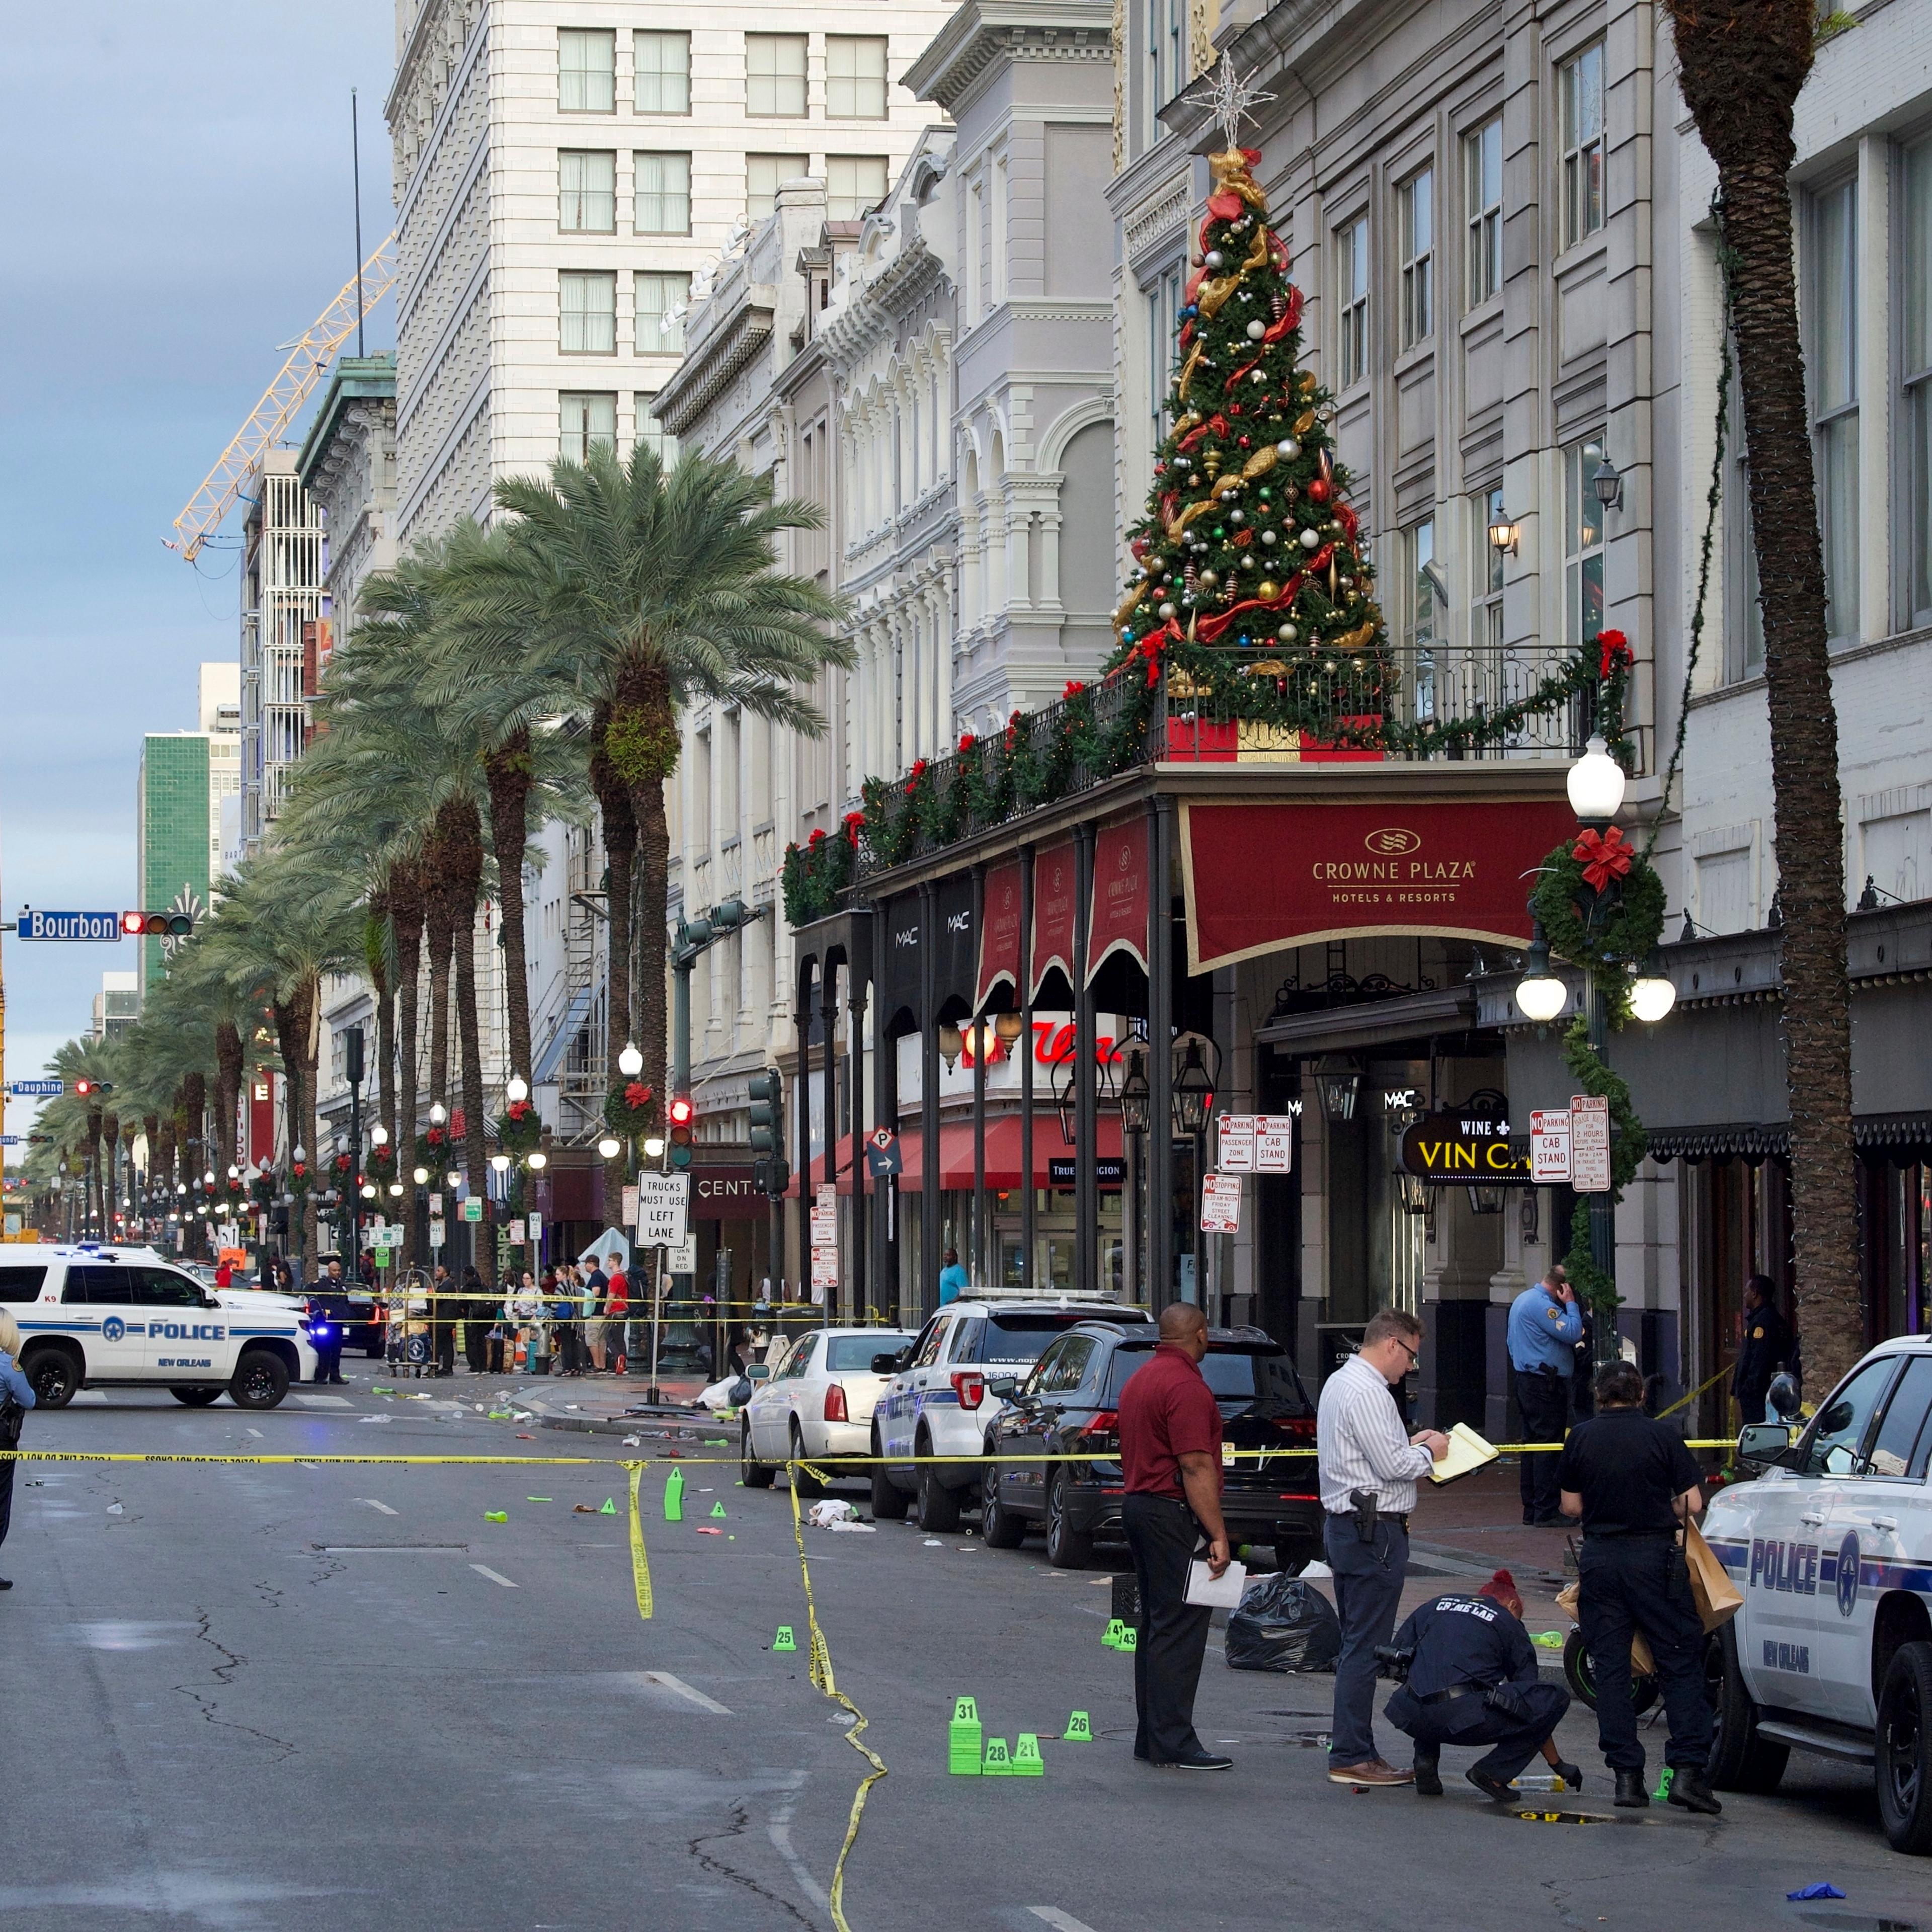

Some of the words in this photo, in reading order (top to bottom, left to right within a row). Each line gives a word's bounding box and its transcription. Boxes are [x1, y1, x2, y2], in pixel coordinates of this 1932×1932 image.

[1313, 862, 1399, 879] CROWNE
[1333, 894, 1380, 903] HOTELS
[1386, 894, 1393, 903] &
[1399, 893, 1456, 902] RESORTS
[32, 912, 113, 938] Bourbon
[947, 911, 970, 933] MAC
[896, 926, 918, 948] MAC
[18, 1082, 62, 1094] Dauphine
[1385, 1090, 1415, 1109] MAC
[1573, 1099, 1581, 1110] NO
[1582, 1099, 1605, 1109] PARKING
[1221, 1120, 1230, 1131] NO
[1257, 1120, 1266, 1132] NO
[1461, 1120, 1491, 1135] WINE
[1532, 1117, 1543, 1130] NO
[1543, 1117, 1569, 1128] PARKING
[878, 1133, 888, 1145] P
[1265, 1137, 1281, 1146] CAB
[1543, 1138, 1560, 1149] CAB
[1260, 1150, 1285, 1159] STAND
[1418, 1142, 1477, 1169] VIN
[1538, 1152, 1566, 1164] STAND
[1053, 1166, 1075, 1175] TRUE
[1096, 1166, 1119, 1175] IGION
[648, 1182, 681, 1192] TRUCKS
[698, 1180, 757, 1198] CENT
[1205, 1179, 1215, 1190] NO
[1215, 1181, 1239, 1190] STOPPING
[640, 1196, 663, 1204] MUST
[669, 1197, 685, 1206] USE
[651, 1211, 674, 1221] LEFT
[649, 1227, 674, 1238] LANE
[148, 1323, 225, 1341] POLICE
[158, 1358, 175, 1367] NEW
[176, 1359, 211, 1367] ORLEANS
[1750, 1538, 1818, 1595] POLICE
[1471, 1606, 1495, 1622] LAB
[1113, 1625, 1122, 1635] 41
[778, 1632, 790, 1644] 25
[1123, 1633, 1136, 1645] 43
[1763, 1640, 1778, 1668] NEW
[1779, 1642, 1809, 1673] ORLEANS
[958, 1704, 974, 1719] 31
[1071, 1717, 1087, 1732] 26
[989, 1746, 1005, 1761] 28
